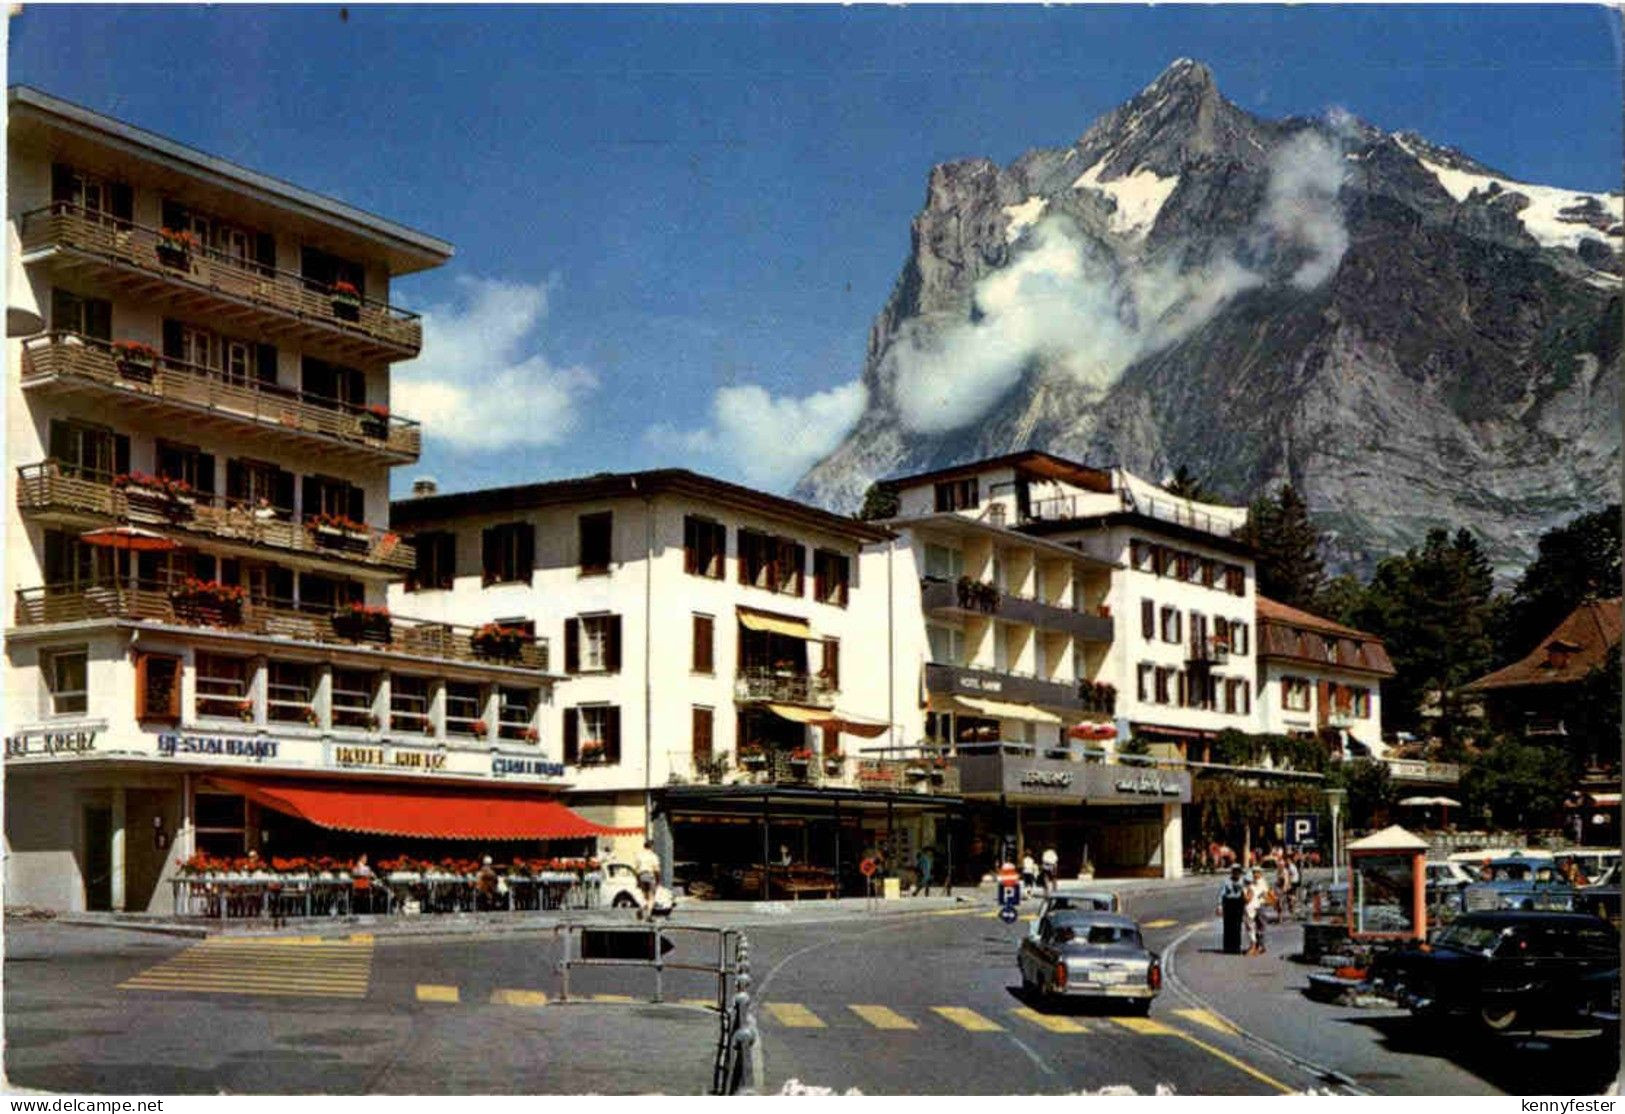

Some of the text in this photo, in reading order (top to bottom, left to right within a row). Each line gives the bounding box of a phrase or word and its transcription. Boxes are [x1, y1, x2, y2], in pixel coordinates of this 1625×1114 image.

[44, 731, 96, 755] KREUZ
[157, 734, 278, 759] RESTAURANT
[336, 746, 383, 765] HOTEL
[1295, 820, 1310, 842] P
[1004, 886, 1015, 902] P
